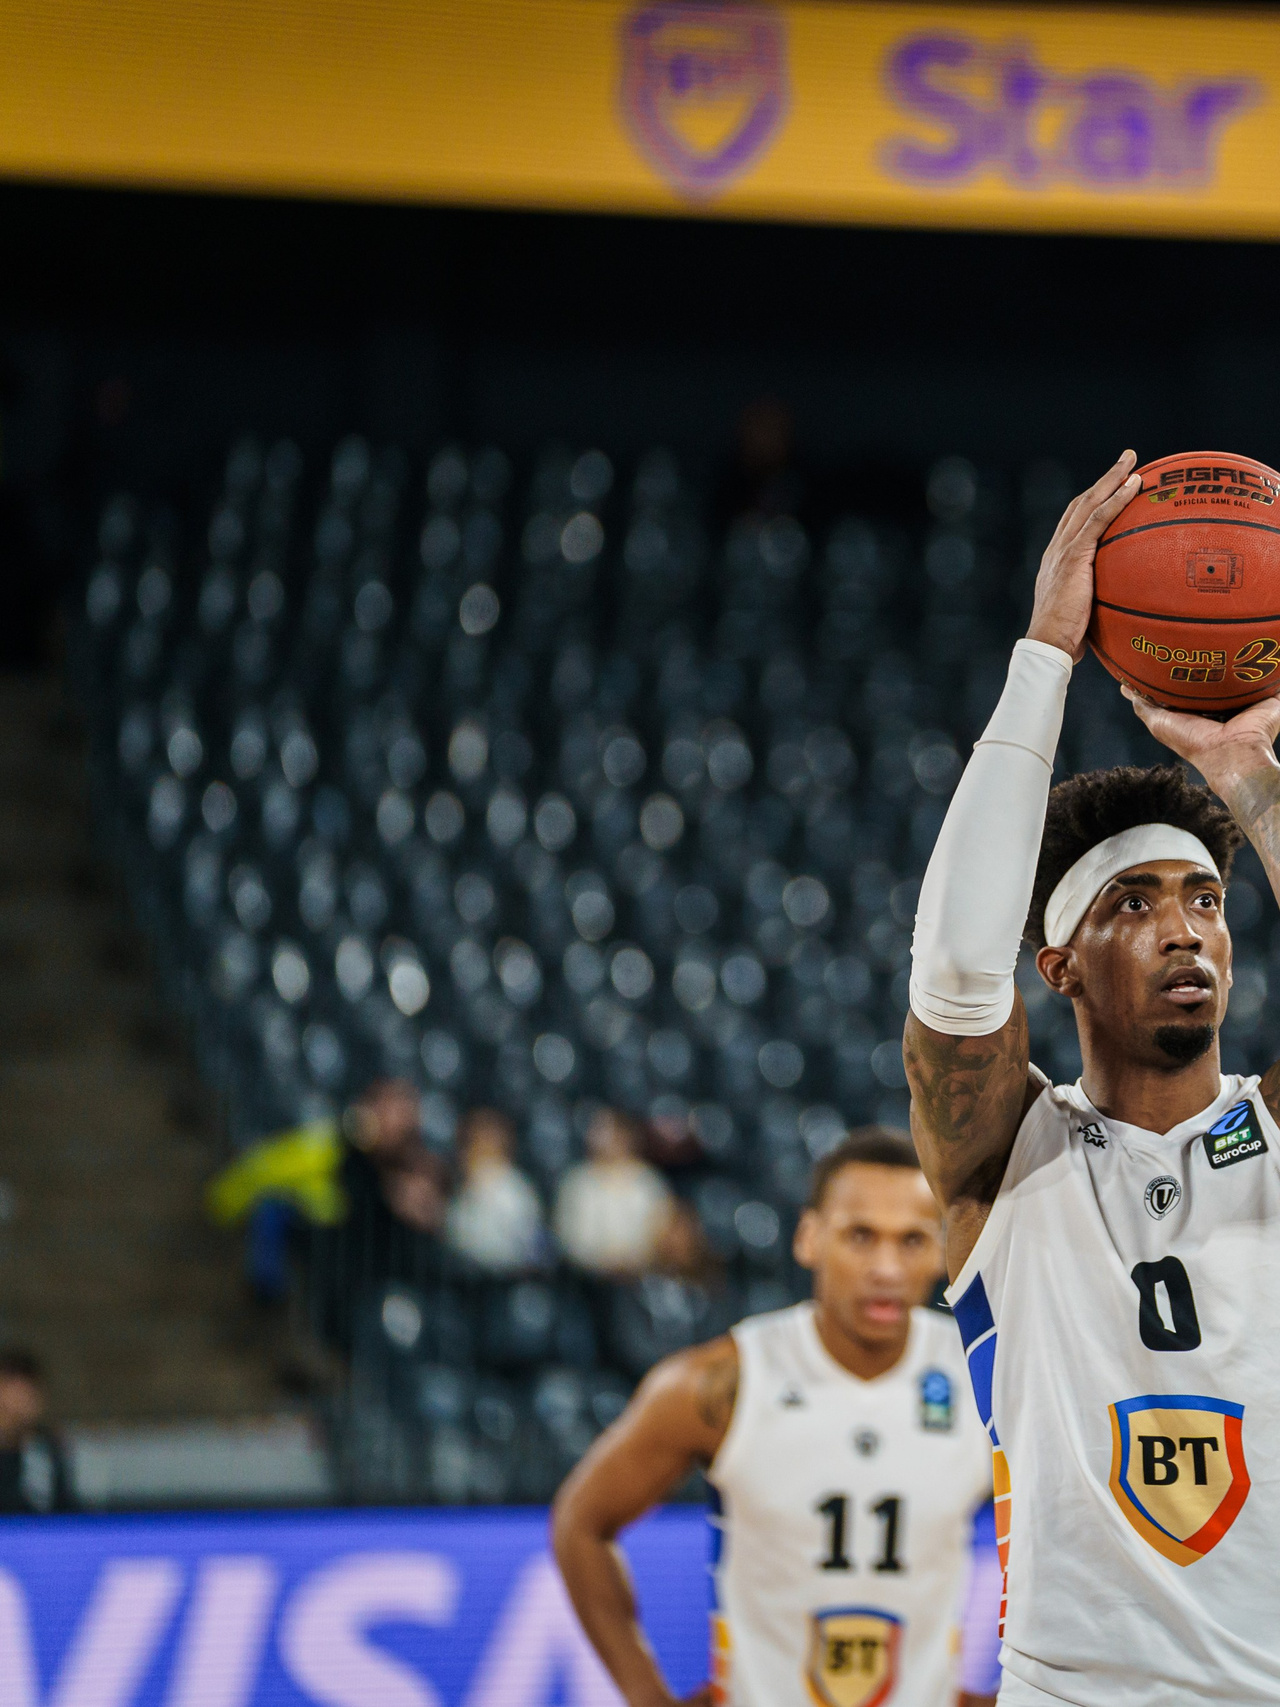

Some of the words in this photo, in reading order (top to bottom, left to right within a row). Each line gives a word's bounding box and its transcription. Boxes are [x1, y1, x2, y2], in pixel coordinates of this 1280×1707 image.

[879, 30, 1263, 191] Star
[1173, 498, 1207, 508] OFFICIAL
[1210, 497, 1231, 506] GAME
[1233, 500, 1251, 509] BALL
[1131, 635, 1226, 667] EuroCup
[1212, 1140, 1262, 1164] EuroCup
[1215, 1127, 1251, 1151] BKT
[1131, 1255, 1201, 1352] 0
[1137, 1435, 1219, 1486] BT
[814, 1491, 907, 1574] 11
